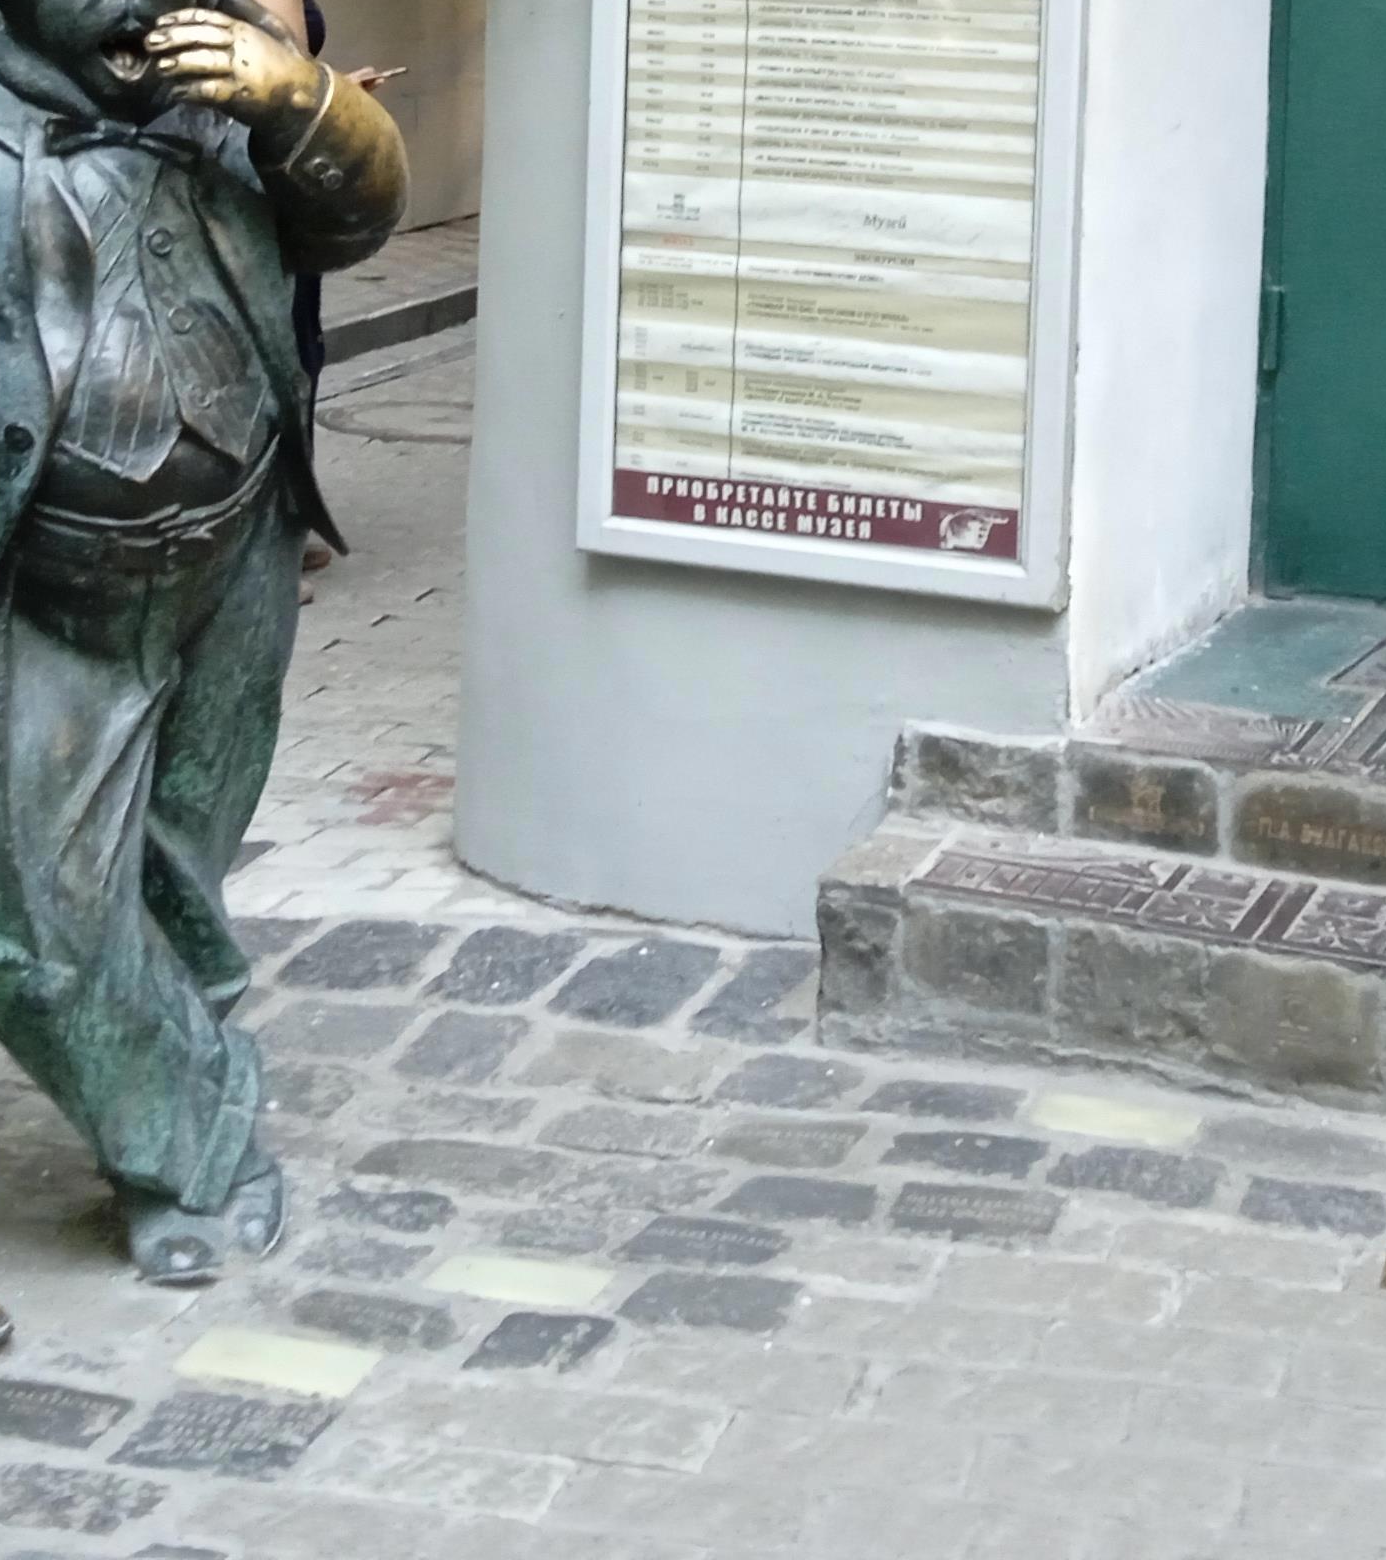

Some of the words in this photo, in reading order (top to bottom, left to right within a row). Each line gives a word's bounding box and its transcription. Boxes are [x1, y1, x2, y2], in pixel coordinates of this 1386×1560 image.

[646, 474, 818, 511] ПРИОБРЕТАЙТЕ
[826, 493, 924, 522] БИЛЕТЫ
[692, 503, 707, 523] В
[715, 505, 788, 531] КАССЕ
[796, 513, 872, 540] МУЗЕЯ
